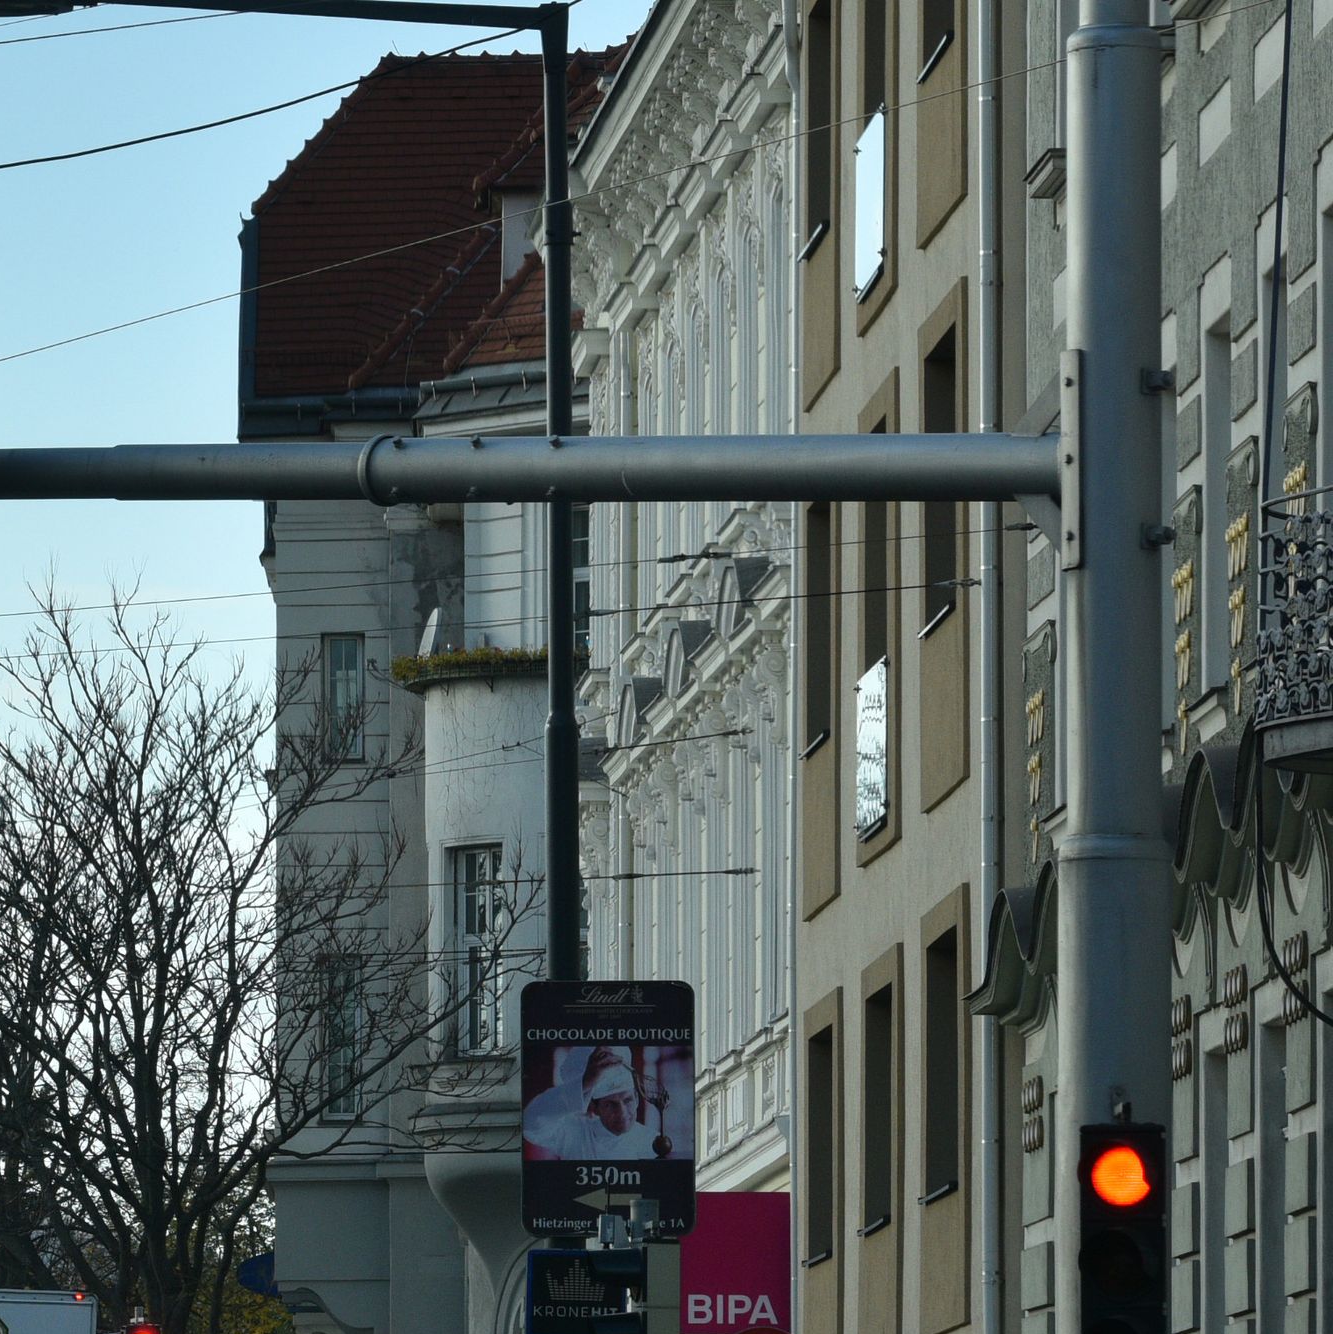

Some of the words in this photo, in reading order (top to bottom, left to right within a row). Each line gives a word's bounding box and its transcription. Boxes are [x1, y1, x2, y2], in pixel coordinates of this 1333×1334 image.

[576, 983, 631, 1004] Lindt
[526, 1027, 614, 1042] CHOCOLADE
[617, 1027, 691, 1043] BOUTIQUE
[574, 1166, 643, 1186] 350m
[532, 1217, 592, 1234] Hietzinger
[670, 1217, 686, 1230] 1A
[687, 1294, 779, 1325] BIPA
